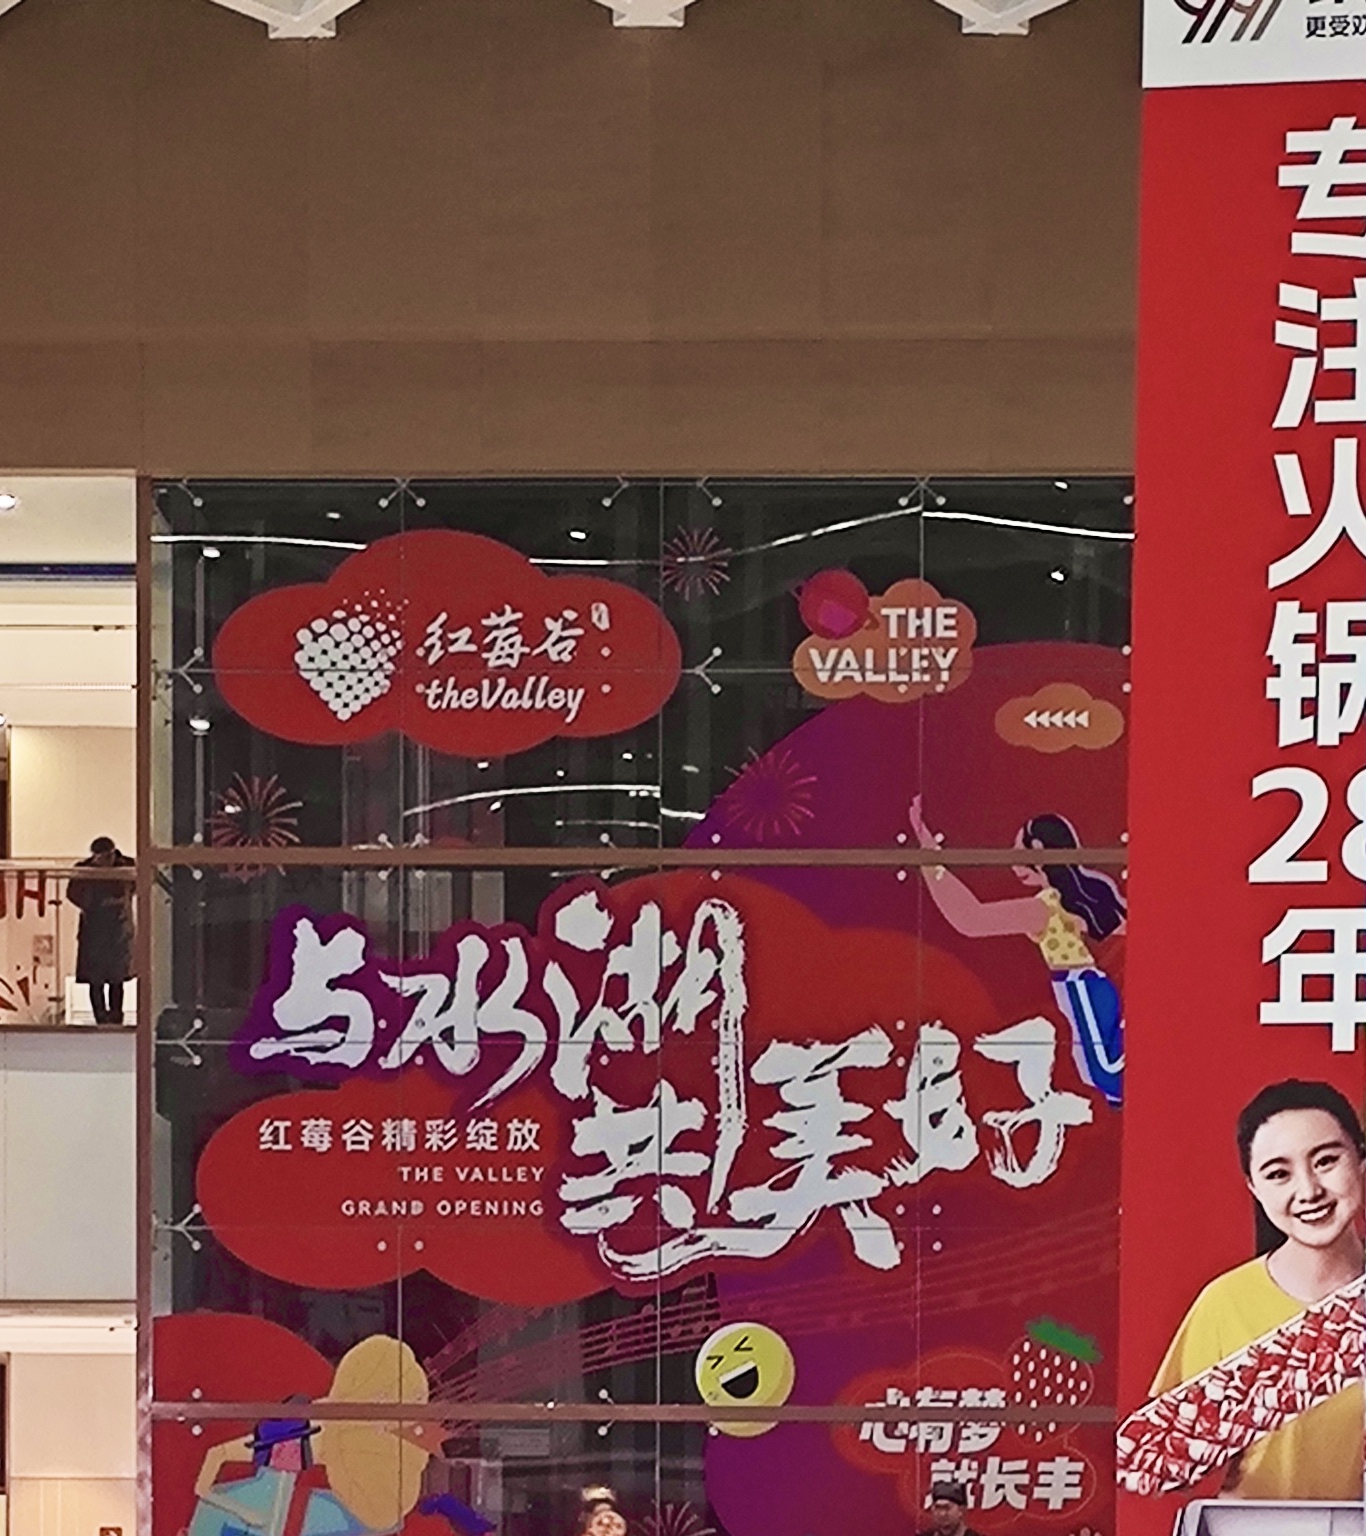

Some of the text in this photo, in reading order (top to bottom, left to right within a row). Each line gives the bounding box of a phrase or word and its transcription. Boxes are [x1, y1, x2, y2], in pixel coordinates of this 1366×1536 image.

[420, 604, 585, 669] 红莓谷
[881, 606, 960, 639] THE
[809, 647, 960, 684] VALLEY
[258, 1117, 541, 1153] 红莓谷精彩绽放
[398, 1166, 545, 1183] THE VALLEY
[341, 1199, 545, 1217] GRAND OPENING
